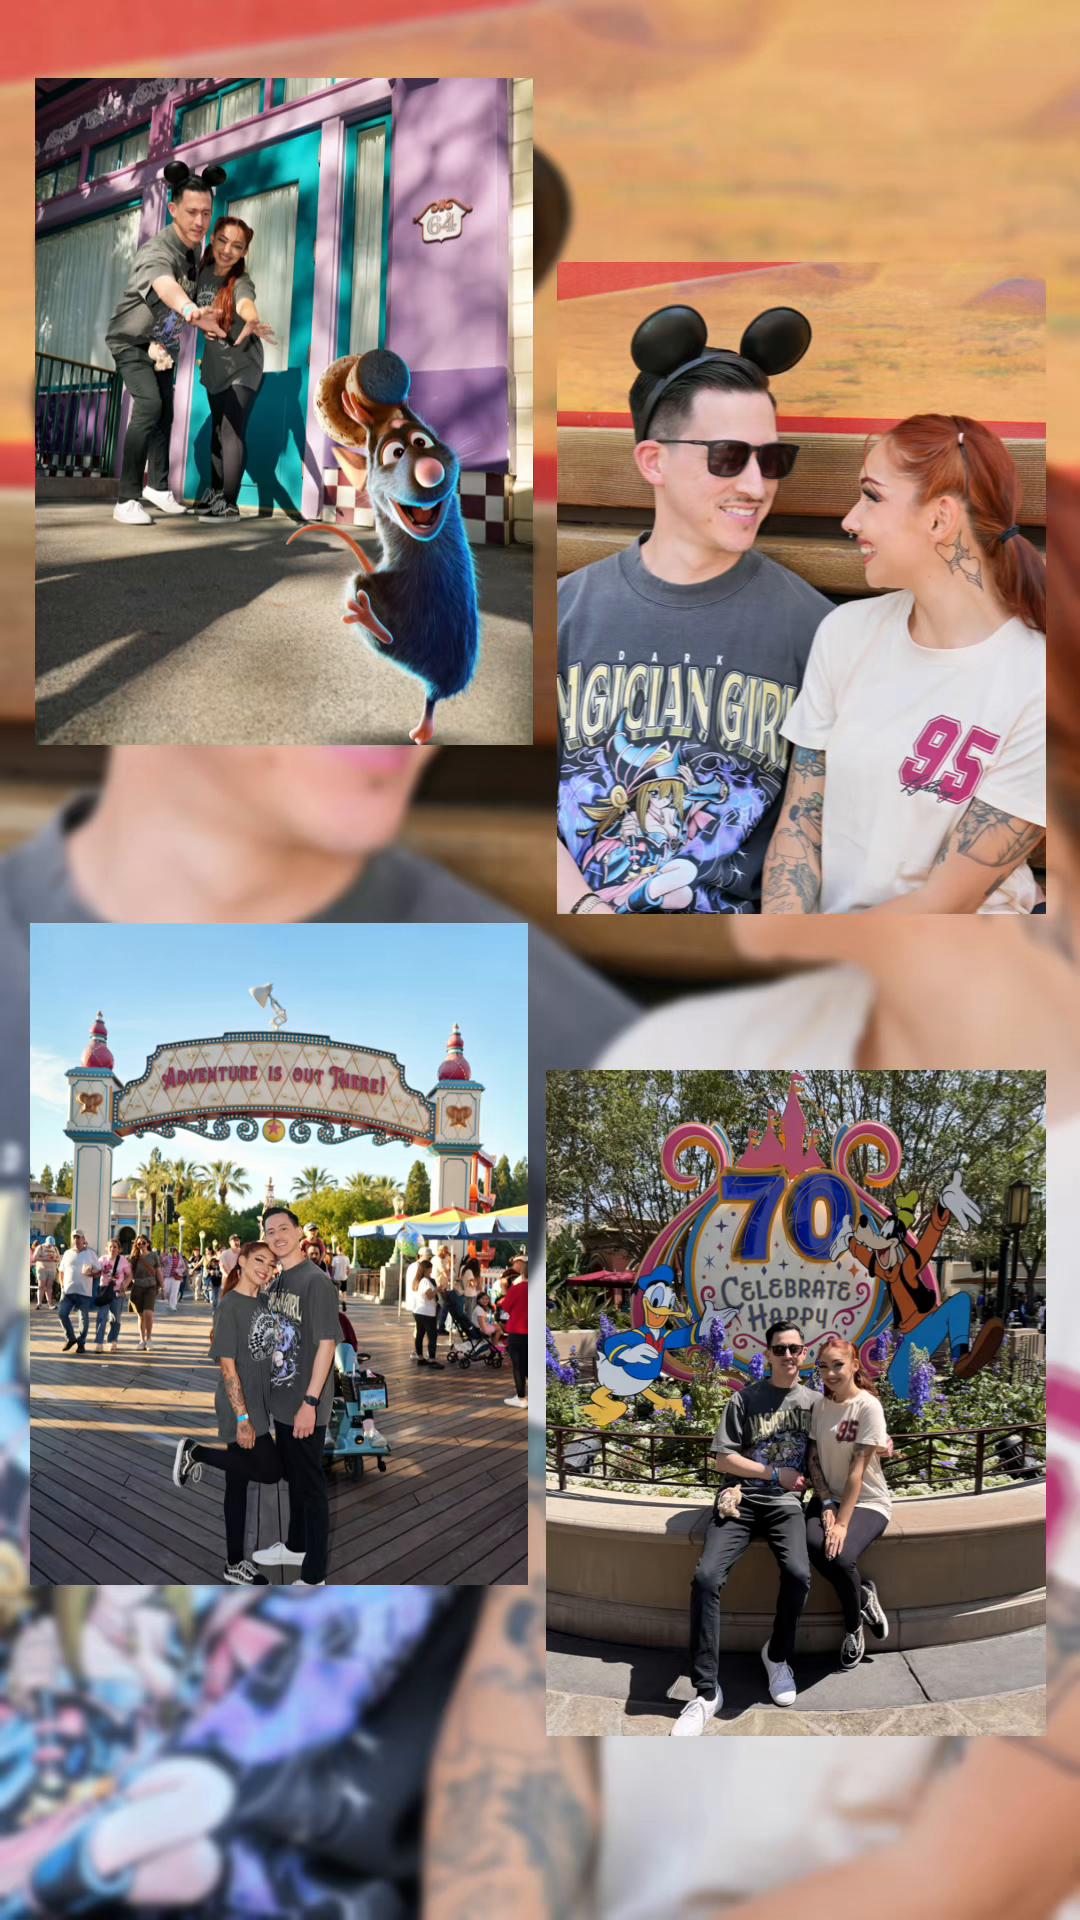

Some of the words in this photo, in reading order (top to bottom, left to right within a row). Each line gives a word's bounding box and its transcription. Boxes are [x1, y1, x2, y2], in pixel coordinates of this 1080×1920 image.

[427, 212, 457, 235] 64
[618, 650, 724, 665] DARK
[898, 714, 1001, 804] 95
[161, 1066, 258, 1089] ADVENTURE
[268, 1066, 282, 1082] IS
[292, 1066, 324, 1086] OUT
[328, 1065, 386, 1097] THERE!
[719, 1167, 859, 1264] 70
[721, 1276, 851, 1309] CELEBRATE
[748, 1302, 829, 1333] HAPPY
[836, 1420, 860, 1443] 95
